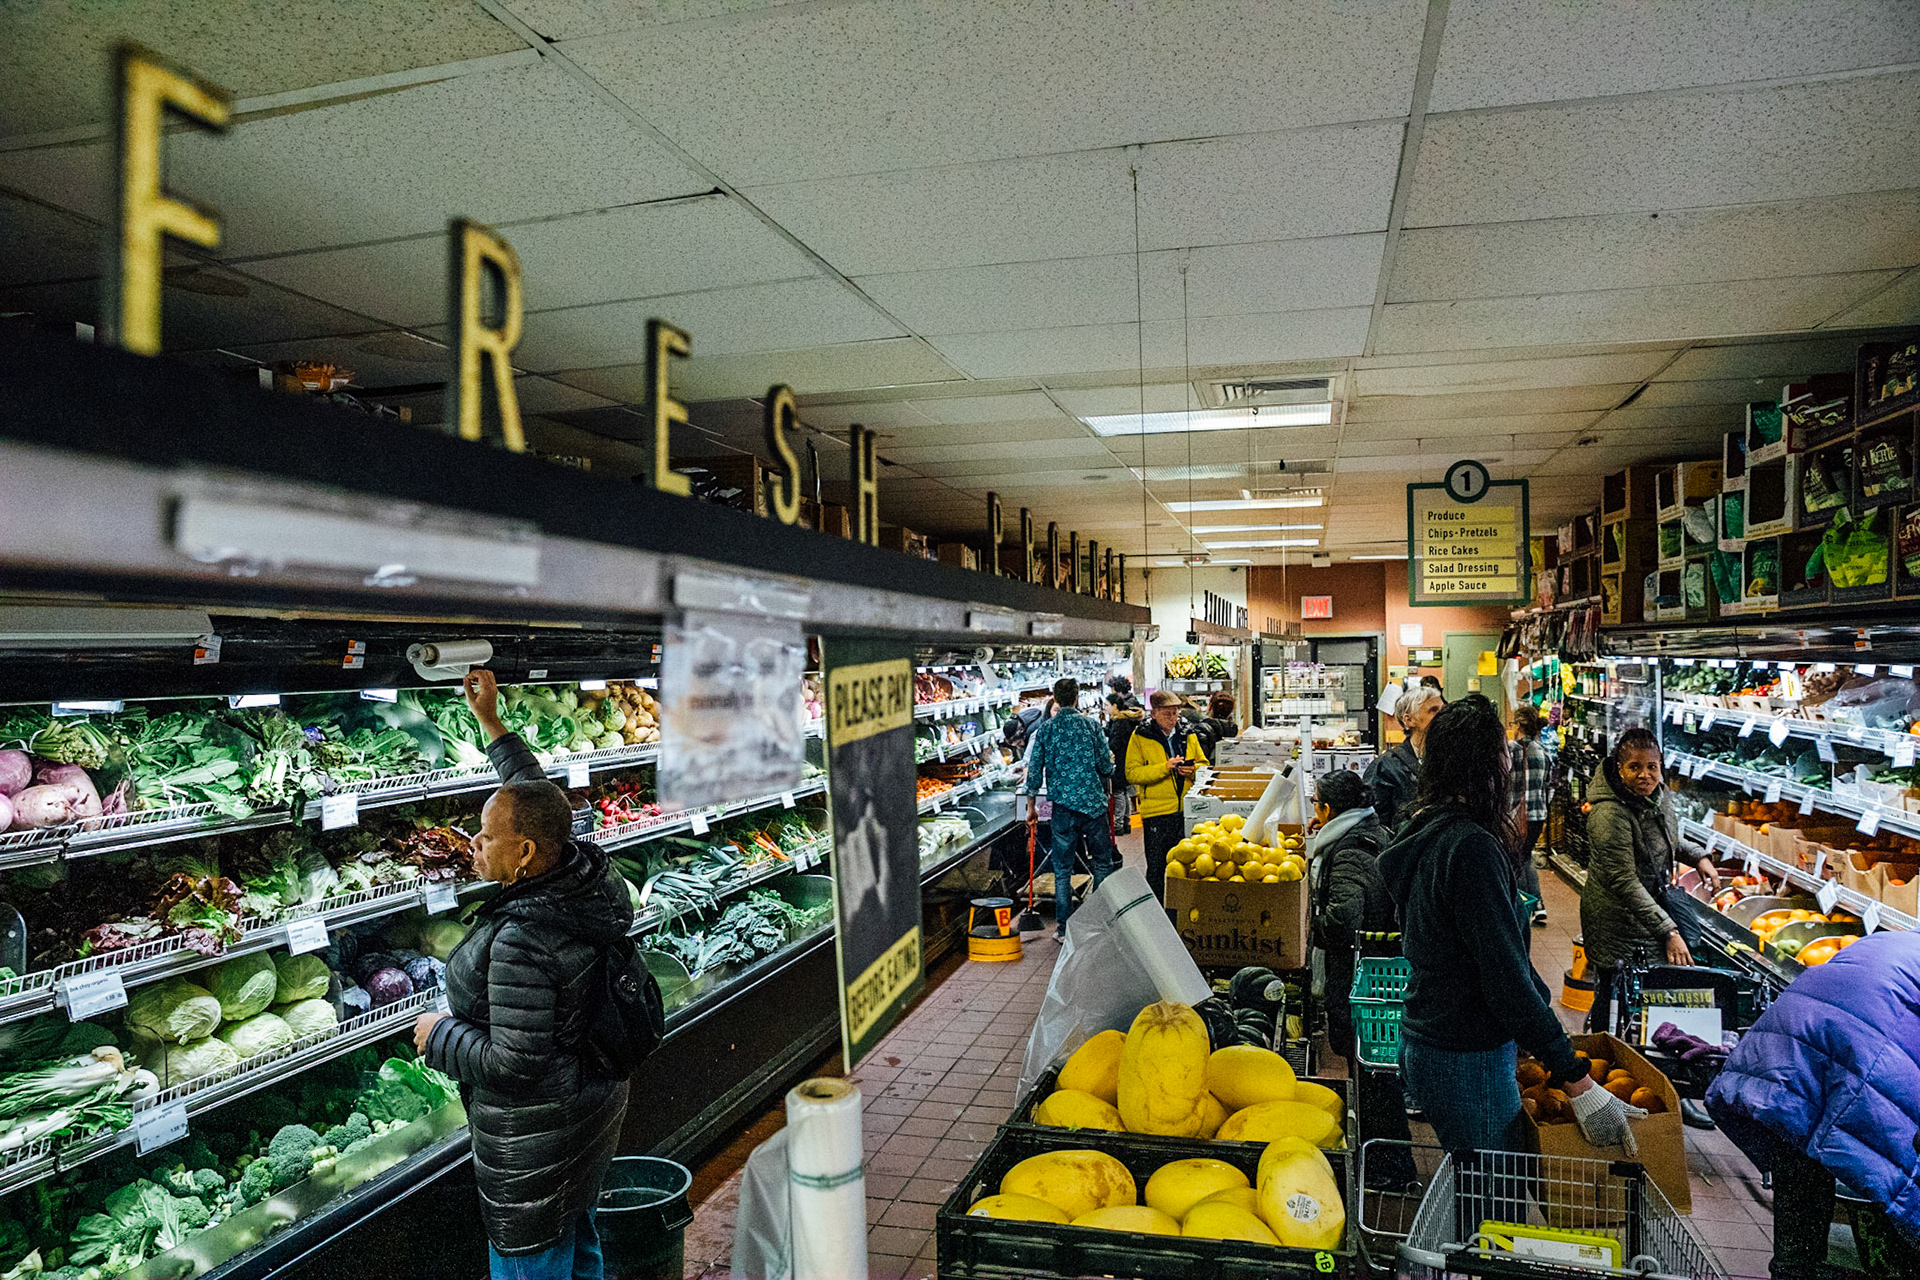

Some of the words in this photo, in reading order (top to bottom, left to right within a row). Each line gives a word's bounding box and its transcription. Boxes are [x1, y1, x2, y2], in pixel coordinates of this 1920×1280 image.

[115, 42, 879, 548] FRESH
[1460, 470, 1471, 492] 1
[1427, 510, 1466, 521] Produce
[1459, 527, 1498, 538] Pretzels
[1428, 546, 1449, 556] Rice
[1451, 545, 1479, 555] Cakes
[1428, 563, 1454, 573] Salad
[1457, 562, 1499, 574] Dressing
[1429, 581, 1455, 593] Apple
[1458, 580, 1487, 590] Sauce
[1306, 599, 1329, 617] EXIT
[837, 677, 885, 731] PLEASE
[888, 670, 909, 712] PAY
[999, 910, 1011, 927] B
[1181, 928, 1285, 957] Sunkist
[850, 974, 885, 1030] BEFORE
[887, 939, 918, 994] EATING
[1642, 992, 1712, 1004] DISRUPTORS
